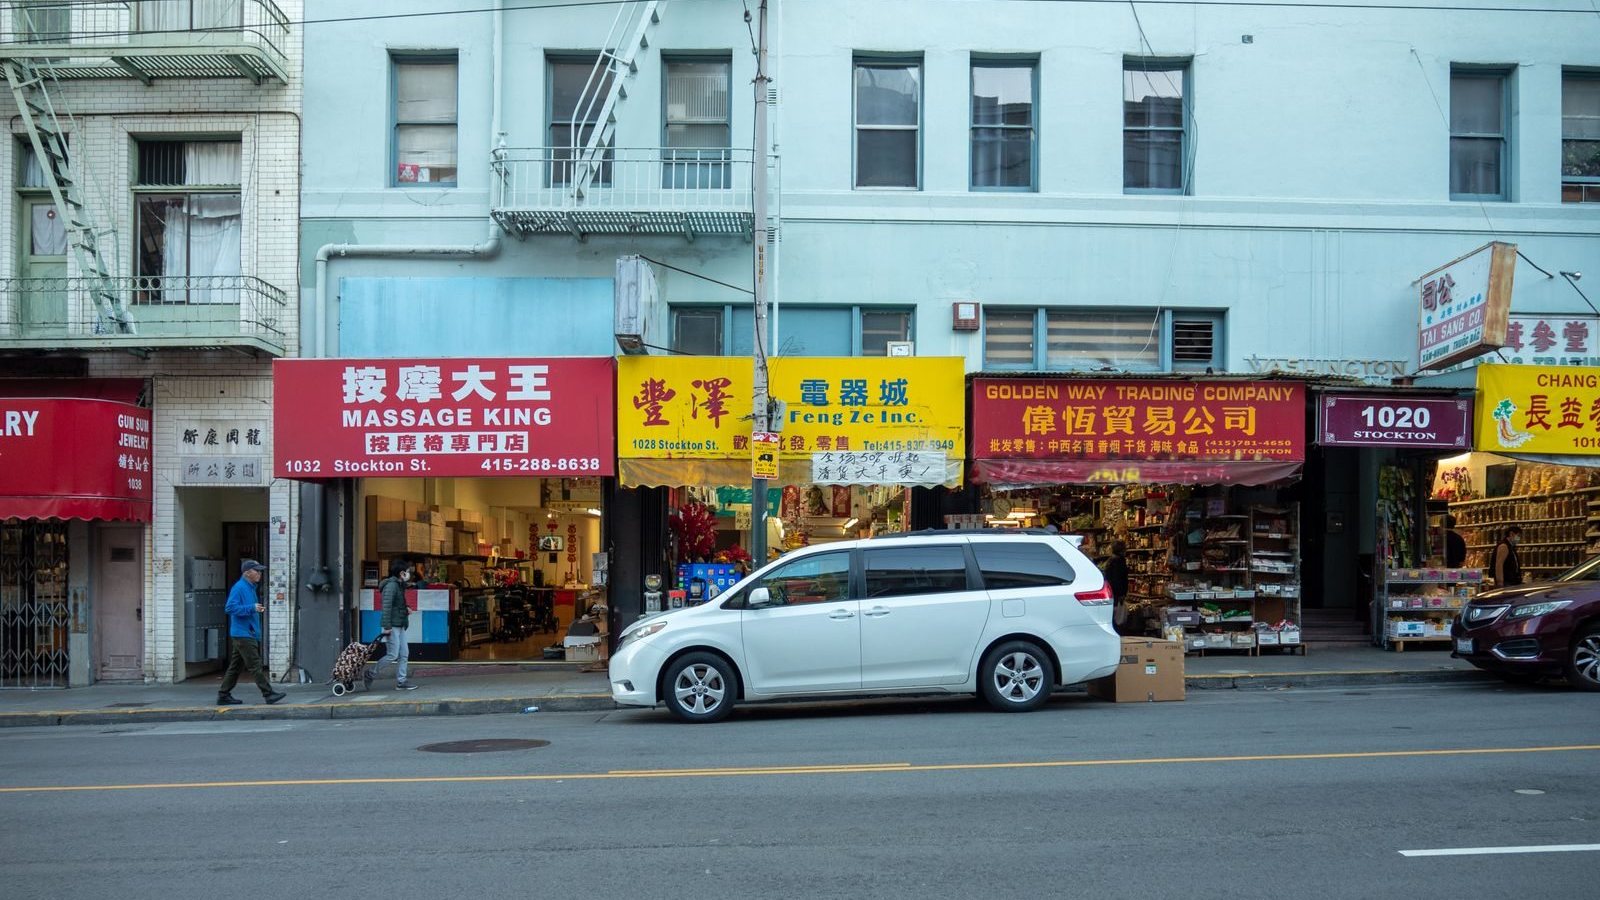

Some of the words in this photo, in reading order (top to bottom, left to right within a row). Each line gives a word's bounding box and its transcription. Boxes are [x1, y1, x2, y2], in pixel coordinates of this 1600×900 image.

[1422, 328, 1436, 347] TAI
[1441, 318, 1465, 340] SANG
[1469, 309, 1483, 327] CO.
[342, 365, 551, 404] 按摩大王
[800, 379, 909, 408] 電器城
[986, 385, 1059, 400] GOLDEN
[1068, 386, 1106, 400] WAY
[1117, 386, 1195, 401] TRADING
[1204, 386, 1294, 402] COMPANY
[0, 410, 39, 436] RY
[117, 413, 134, 430] GUM
[343, 409, 472, 428] MASSAGE
[484, 408, 552, 426] KING
[790, 410, 844, 427] Feng
[850, 410, 875, 424] Ze
[881, 410, 923, 425] Inc.
[1361, 406, 1430, 428] 1020
[118, 433, 149, 450] JEWELRY
[370, 434, 525, 453] 按摩椅專門店
[1205, 439, 1292, 447] (415)781-4650
[1354, 430, 1436, 440] STOCKTON
[632, 438, 656, 450] 1028
[658, 438, 703, 451] Stockton
[705, 439, 719, 451] St.
[285, 460, 321, 473] 1032
[334, 459, 404, 473] Stockton
[410, 459, 431, 472] St.
[481, 458, 600, 471] 415-288-8638
[127, 478, 142, 490] 1038
